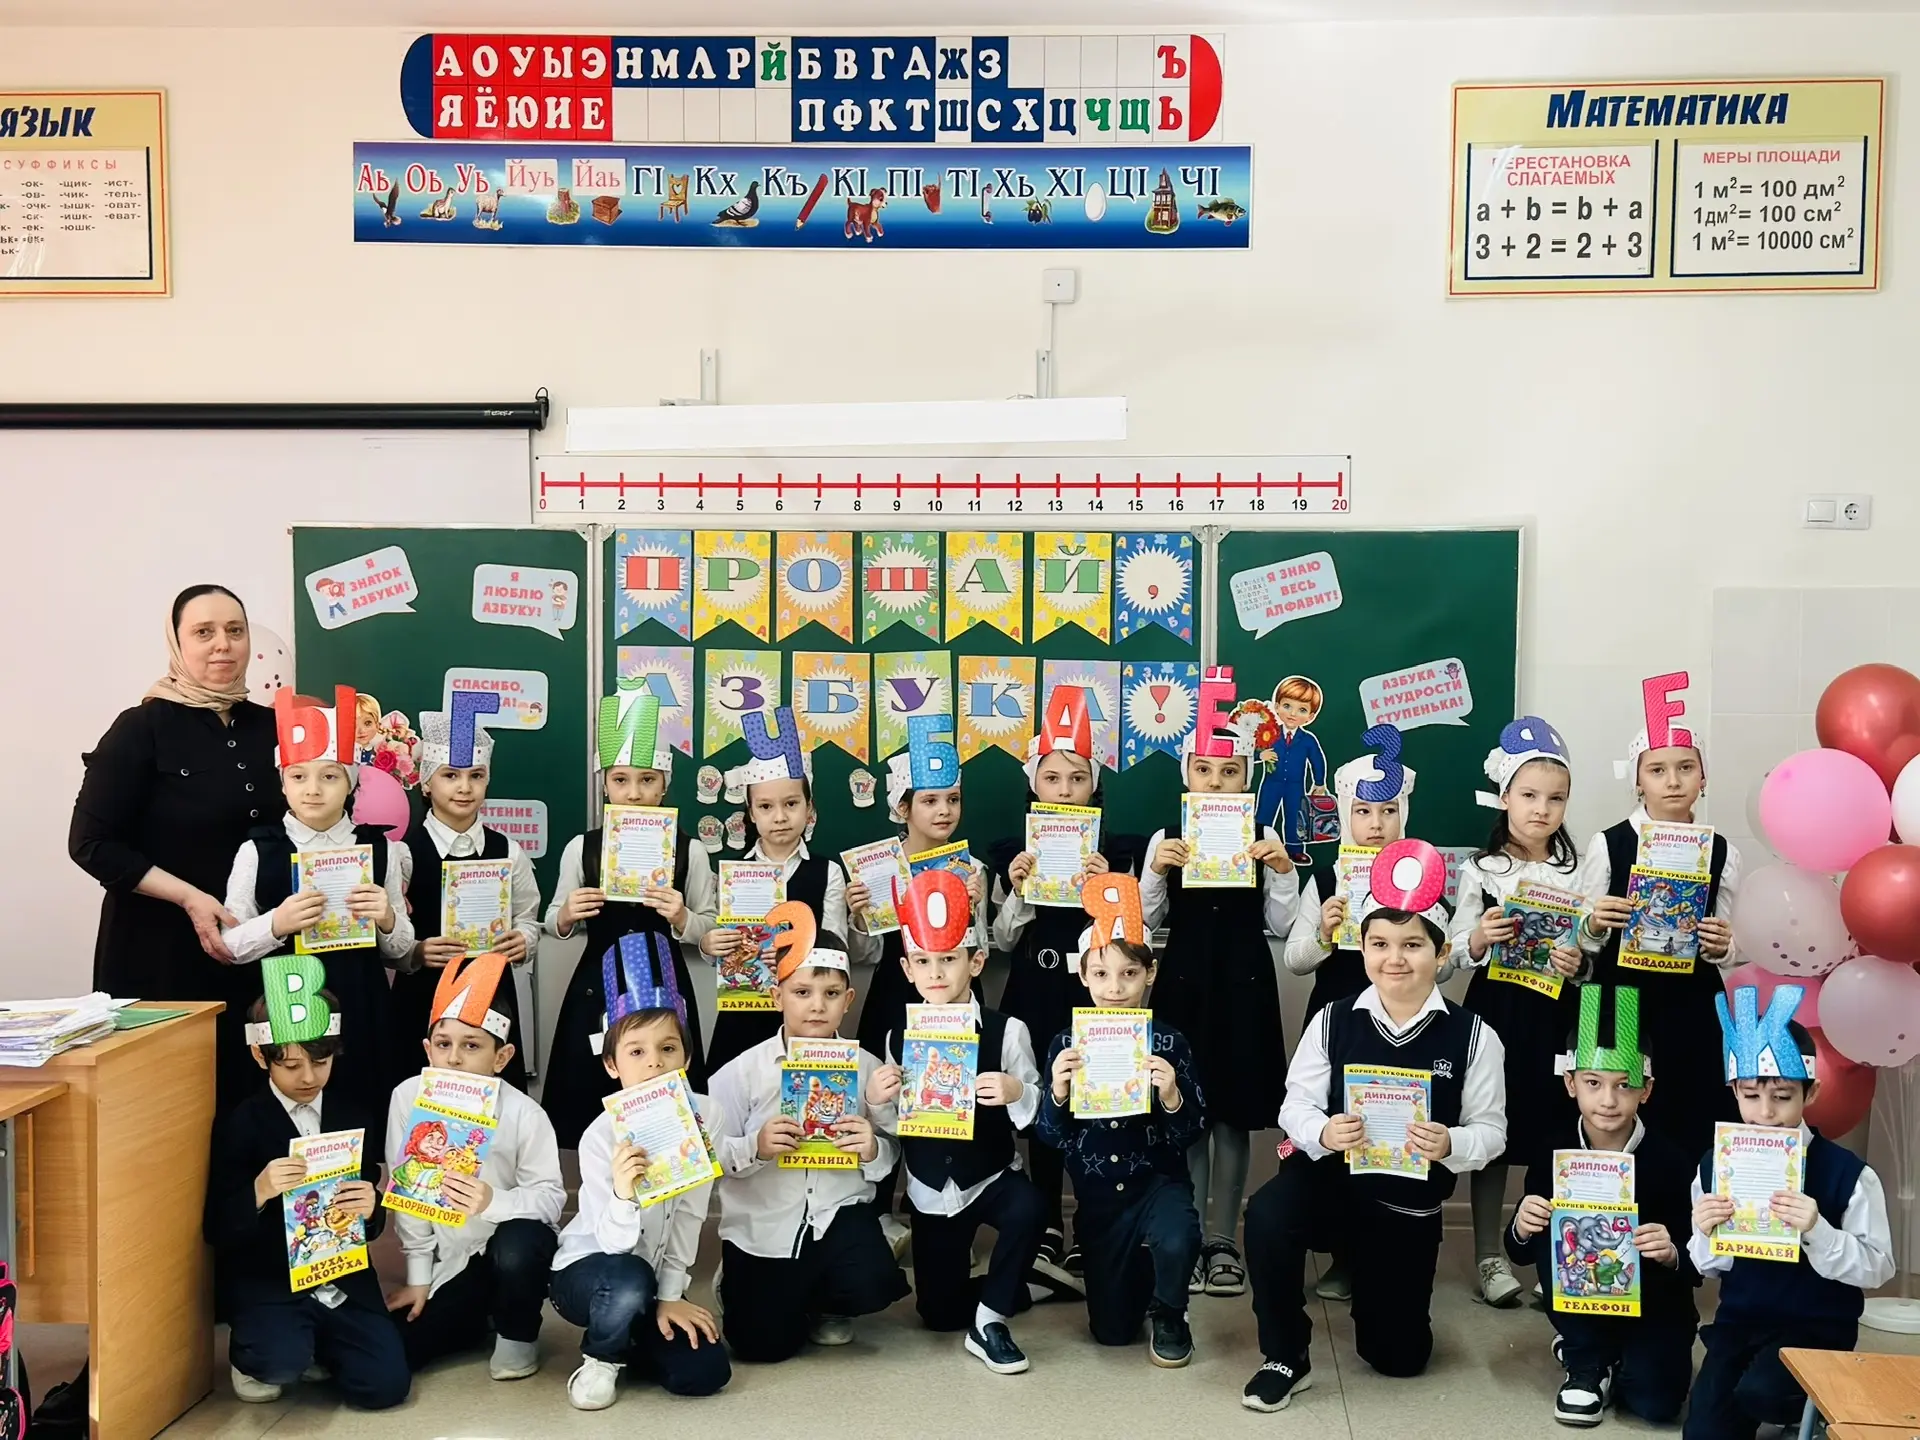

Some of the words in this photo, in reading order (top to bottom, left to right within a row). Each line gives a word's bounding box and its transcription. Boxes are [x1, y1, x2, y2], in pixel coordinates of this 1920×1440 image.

[1492, 154, 1631, 171] ЕРЕСТАНОВКА
[1703, 150, 1752, 165] МЕРЫ
[1756, 149, 1841, 166] ПЛОЩАДИ
[1507, 171, 1616, 187] СЛАГАЕМЫХ
[1760, 181, 1797, 198] 100
[1759, 206, 1796, 223] 100
[1476, 235, 1490, 259] 3
[1526, 234, 1541, 259] 2
[1577, 234, 1592, 259] 2
[1628, 232, 1642, 258] 3
[1757, 231, 1813, 251] 10000
[540, 499, 546, 509] 0
[579, 499, 584, 509] 1
[618, 499, 625, 509] 2
[658, 500, 664, 510] 3
[696, 500, 703, 510] 4
[737, 500, 743, 510] 5
[776, 500, 783, 510] 6
[814, 501, 821, 511] 7
[854, 500, 861, 511] 8
[893, 500, 900, 511] 9
[928, 501, 942, 511] 10
[968, 501, 980, 511] 11
[1008, 501, 1022, 511] 12
[1048, 500, 1062, 511] 13
[1089, 500, 1103, 510] 14
[1128, 500, 1143, 511] 15
[1169, 500, 1183, 510] 16
[1210, 500, 1224, 510] 17
[1250, 500, 1264, 510] 18
[1292, 500, 1307, 510] 19
[1332, 500, 1347, 510] 20
[365, 558, 376, 570] Я
[1267, 571, 1276, 583] Я
[1280, 560, 1321, 580] ЗНАЮ
[349, 566, 402, 592] ЗНАТОК
[510, 571, 520, 582] Я
[352, 580, 411, 610] АЗБУКИ!
[483, 585, 544, 601] ЛЮБЛЮ
[1280, 579, 1317, 597] ВЕСЬ
[482, 602, 542, 618] АЗБУКУ!
[1265, 590, 1339, 618] АЛФАВИТ!
[452, 679, 525, 693] СПАСИБО,
[1382, 668, 1436, 691] АЗБУКА
[1370, 698, 1381, 711] К
[1383, 679, 1462, 708] МУДРОСТИ
[1196, 666, 1236, 758] Ё
[1375, 695, 1465, 724] СТУПЕНЬКА!
[1642, 671, 1692, 750] Е
[275, 684, 356, 768] Ы
[449, 691, 500, 769] Г
[598, 677, 660, 769] Й
[1038, 685, 1093, 759] А
[741, 705, 806, 779] Ч
[907, 714, 960, 791] Б
[1201, 804, 1242, 814] ДИПЛОМ
[486, 822, 539, 834] УЧШЕЕ
[622, 817, 662, 828] ДИПЛОМ
[1040, 824, 1080, 834] ДИПЛОМ
[1653, 833, 1698, 846] ДИПЛОМ
[314, 854, 358, 867] ДИПЛОМ
[856, 849, 892, 866] ДИПЛОМ
[459, 870, 500, 881] ДИПЛОМ
[733, 870, 773, 880] ДИПЛОМ
[1370, 838, 1447, 913] О
[1527, 889, 1571, 907] ДИПЛОМ
[1080, 872, 1144, 949] Я
[765, 900, 817, 982] Э
[1621, 955, 1692, 971] МОЙДОДЫР
[429, 951, 508, 1029] И
[1498, 971, 1553, 993] ТЕЛЕФОН
[261, 954, 330, 1045] В
[920, 1015, 961, 1025] ДИПЛОМ
[1088, 1026, 1133, 1037] ДИПЛОМ
[1576, 984, 1645, 1089] Ц
[1715, 984, 1809, 1086] Ж
[803, 1050, 846, 1060] ДИПЛОМ
[435, 1080, 483, 1096] ДИПЛОМ
[1364, 1091, 1412, 1102] ДИПЛОМ
[622, 1086, 669, 1112] ДИПЛОМ
[901, 1124, 968, 1136] ПУТАНИЦА
[305, 1141, 350, 1158] ДИПЛОМ
[1732, 1136, 1785, 1149] ДИПЛОМ
[783, 1155, 854, 1165] ПУТАНИЦА
[1570, 1161, 1619, 1173] ДИПЛОМ
[385, 1195, 435, 1218] ФЕДОРИНО
[437, 1209, 462, 1224] ГОРЕ
[1715, 1241, 1795, 1259] БАРМАЛЕЙ
[310, 1254, 348, 1274] МУХА-
[296, 1258, 364, 1288] ЦОКОТУХА
[1562, 1300, 1631, 1313] ТЕЛЕФОН
